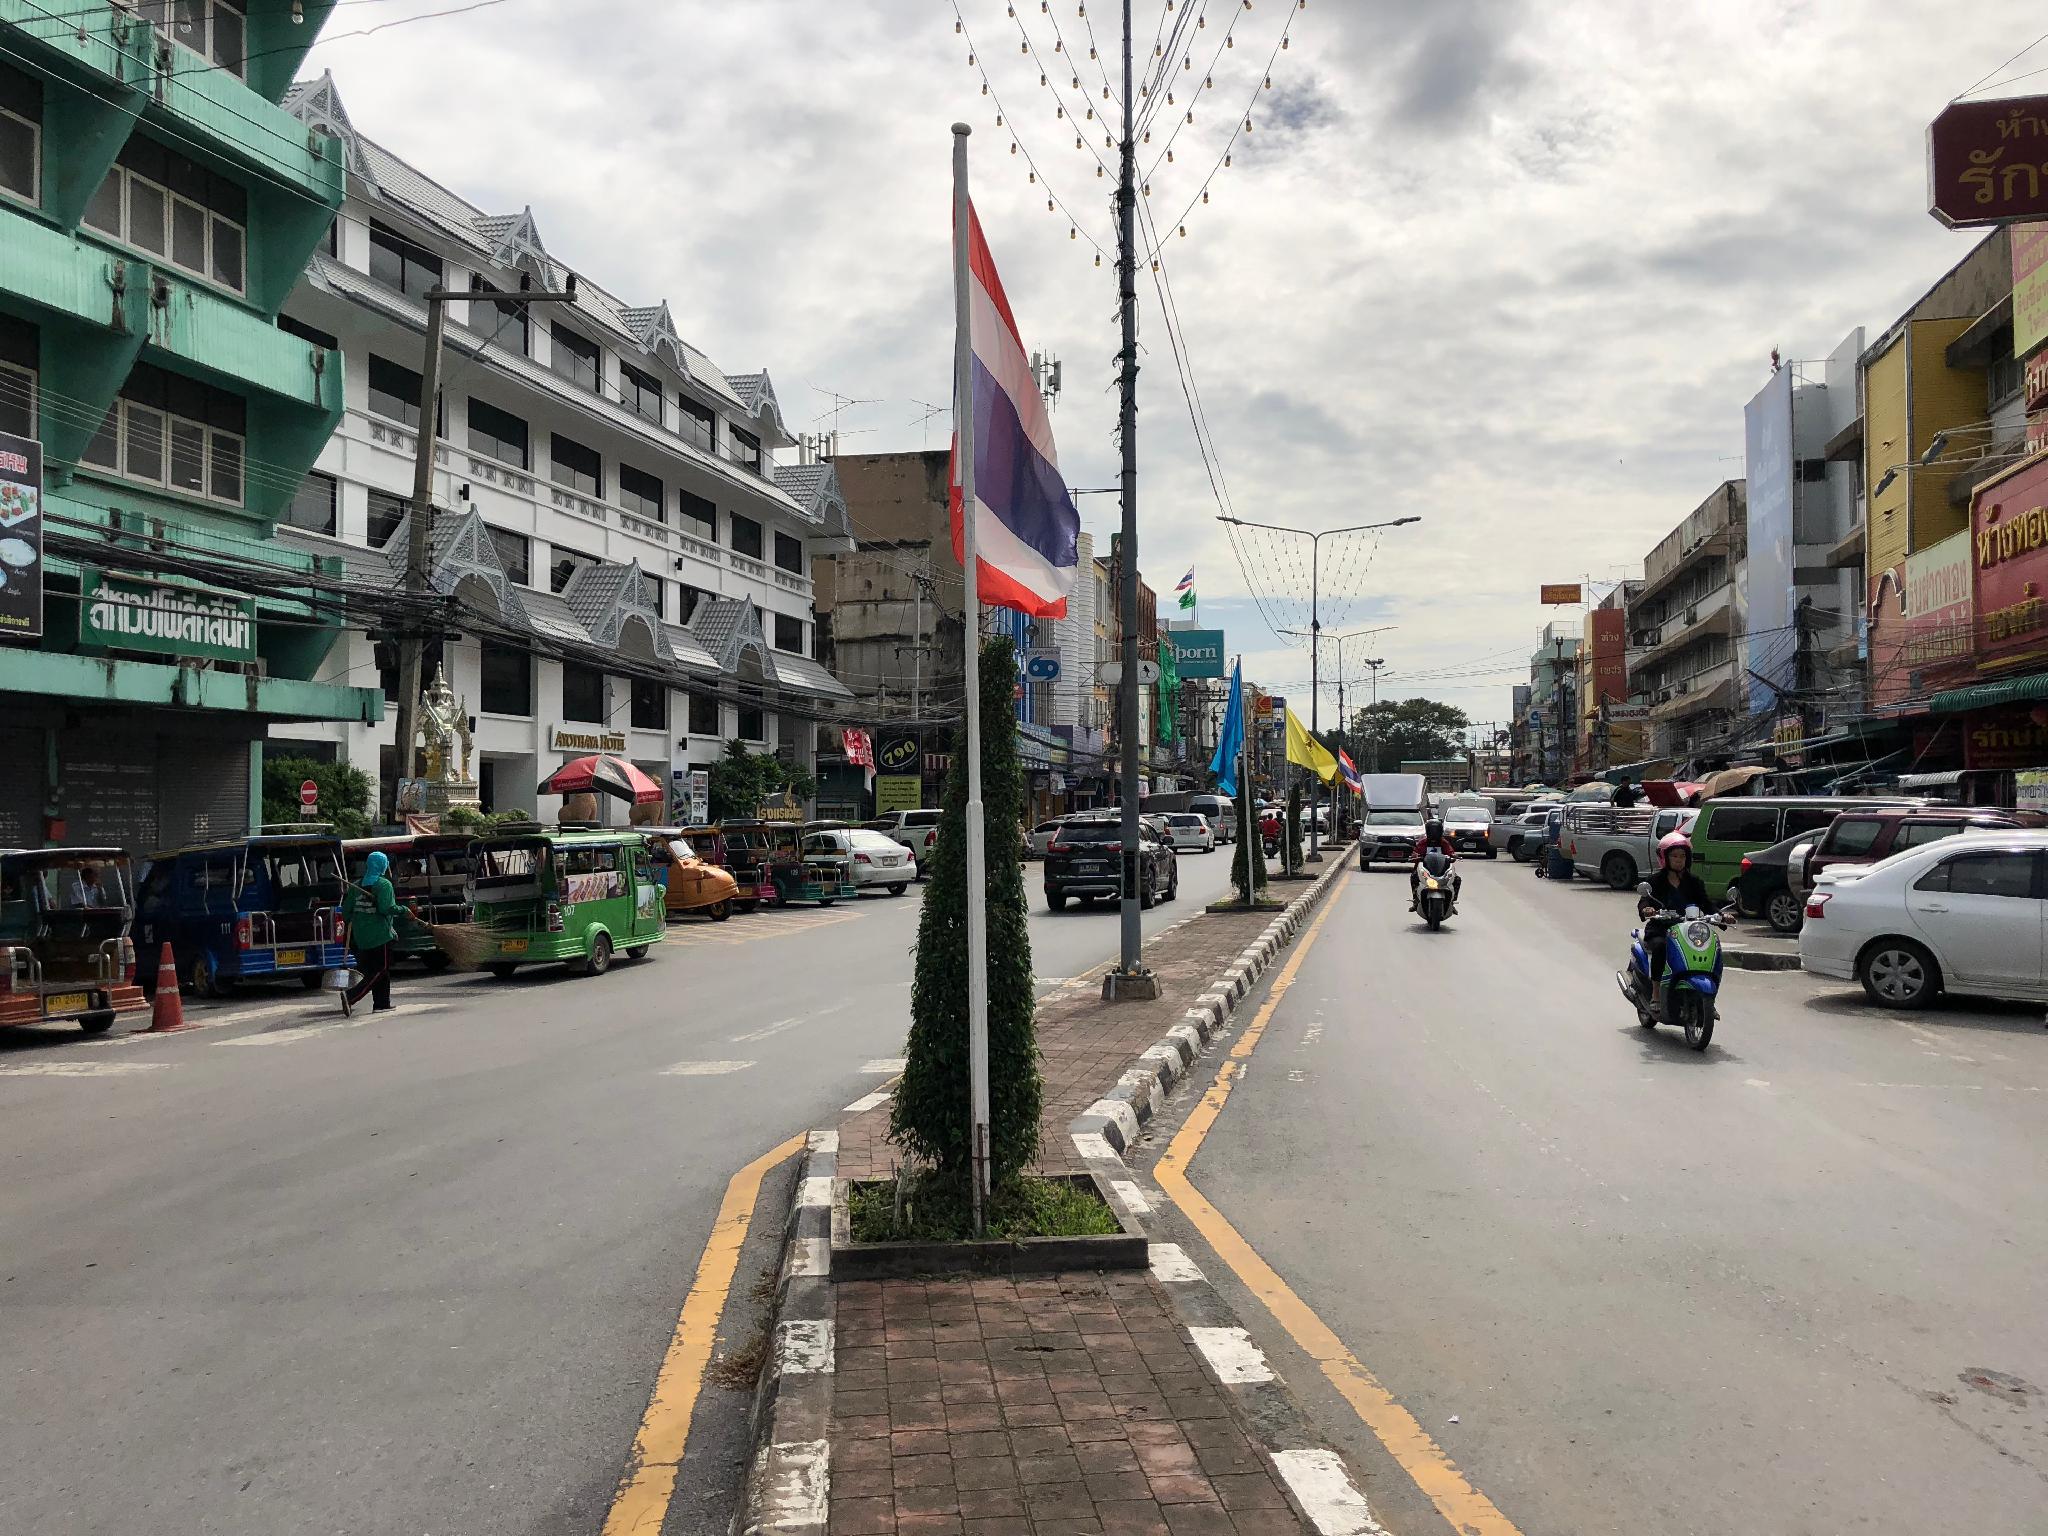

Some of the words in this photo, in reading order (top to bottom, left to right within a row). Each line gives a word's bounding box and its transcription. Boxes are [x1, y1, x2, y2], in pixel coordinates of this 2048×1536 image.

[600, 735, 627, 751] HOTEL
[884, 740, 916, 765] 790
[564, 904, 576, 917] 107
[221, 922, 231, 935] 111
